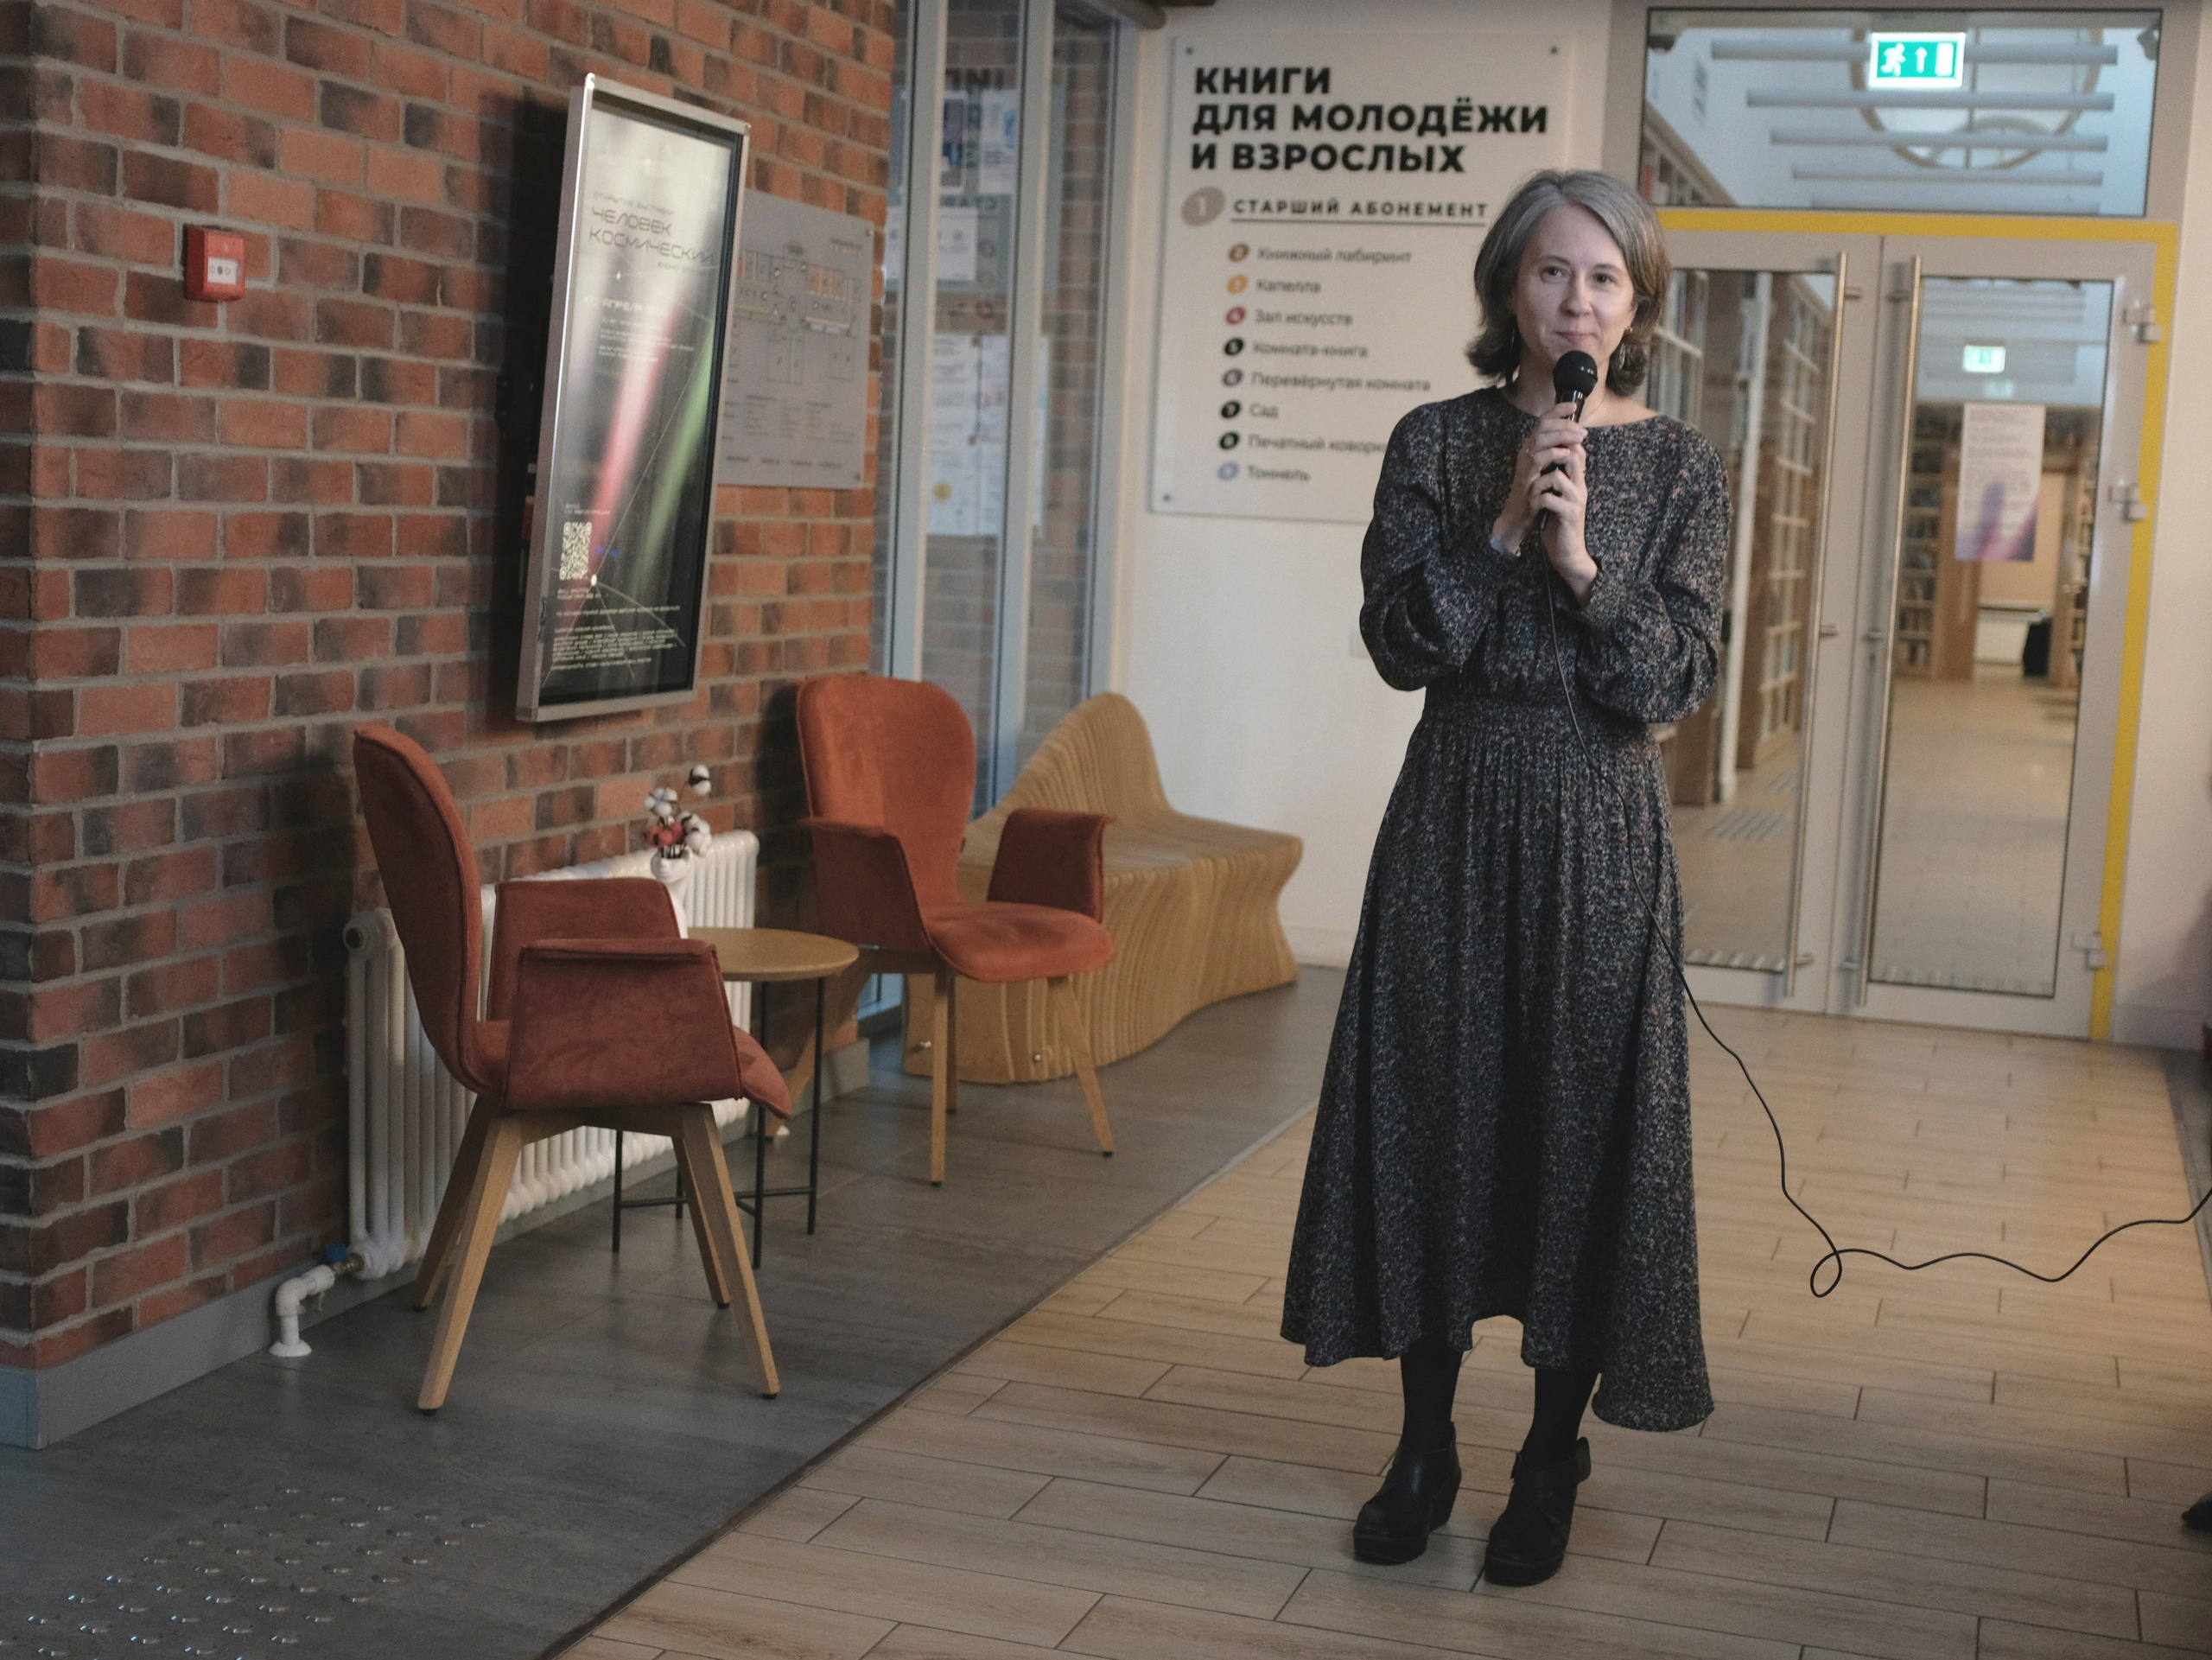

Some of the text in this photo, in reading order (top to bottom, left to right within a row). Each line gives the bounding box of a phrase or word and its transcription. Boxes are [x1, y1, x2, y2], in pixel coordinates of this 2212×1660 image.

[1196, 67, 1332, 94] КНИГИ
[1192, 97, 1548, 137] ДЛЯ МОЛОДЁЖИ
[1192, 143, 1465, 173] И ВЗРОСЛЫХ
[1234, 198, 1488, 219] СТАРШИЙ АБОНЕМЕНТ
[592, 206, 672, 236] ЧЕЛОВЕК
[1257, 246, 1333, 261] Книжный
[1335, 247, 1413, 264] лабиринт
[1255, 278, 1322, 293] Капелла
[1255, 308, 1283, 324] Зал
[1285, 313, 1353, 328] искусств
[1365, 378, 1431, 391] комната
[1249, 403, 1279, 418] Сад
[1249, 434, 1325, 448] Печатный
[1329, 440, 1387, 455] коворк
